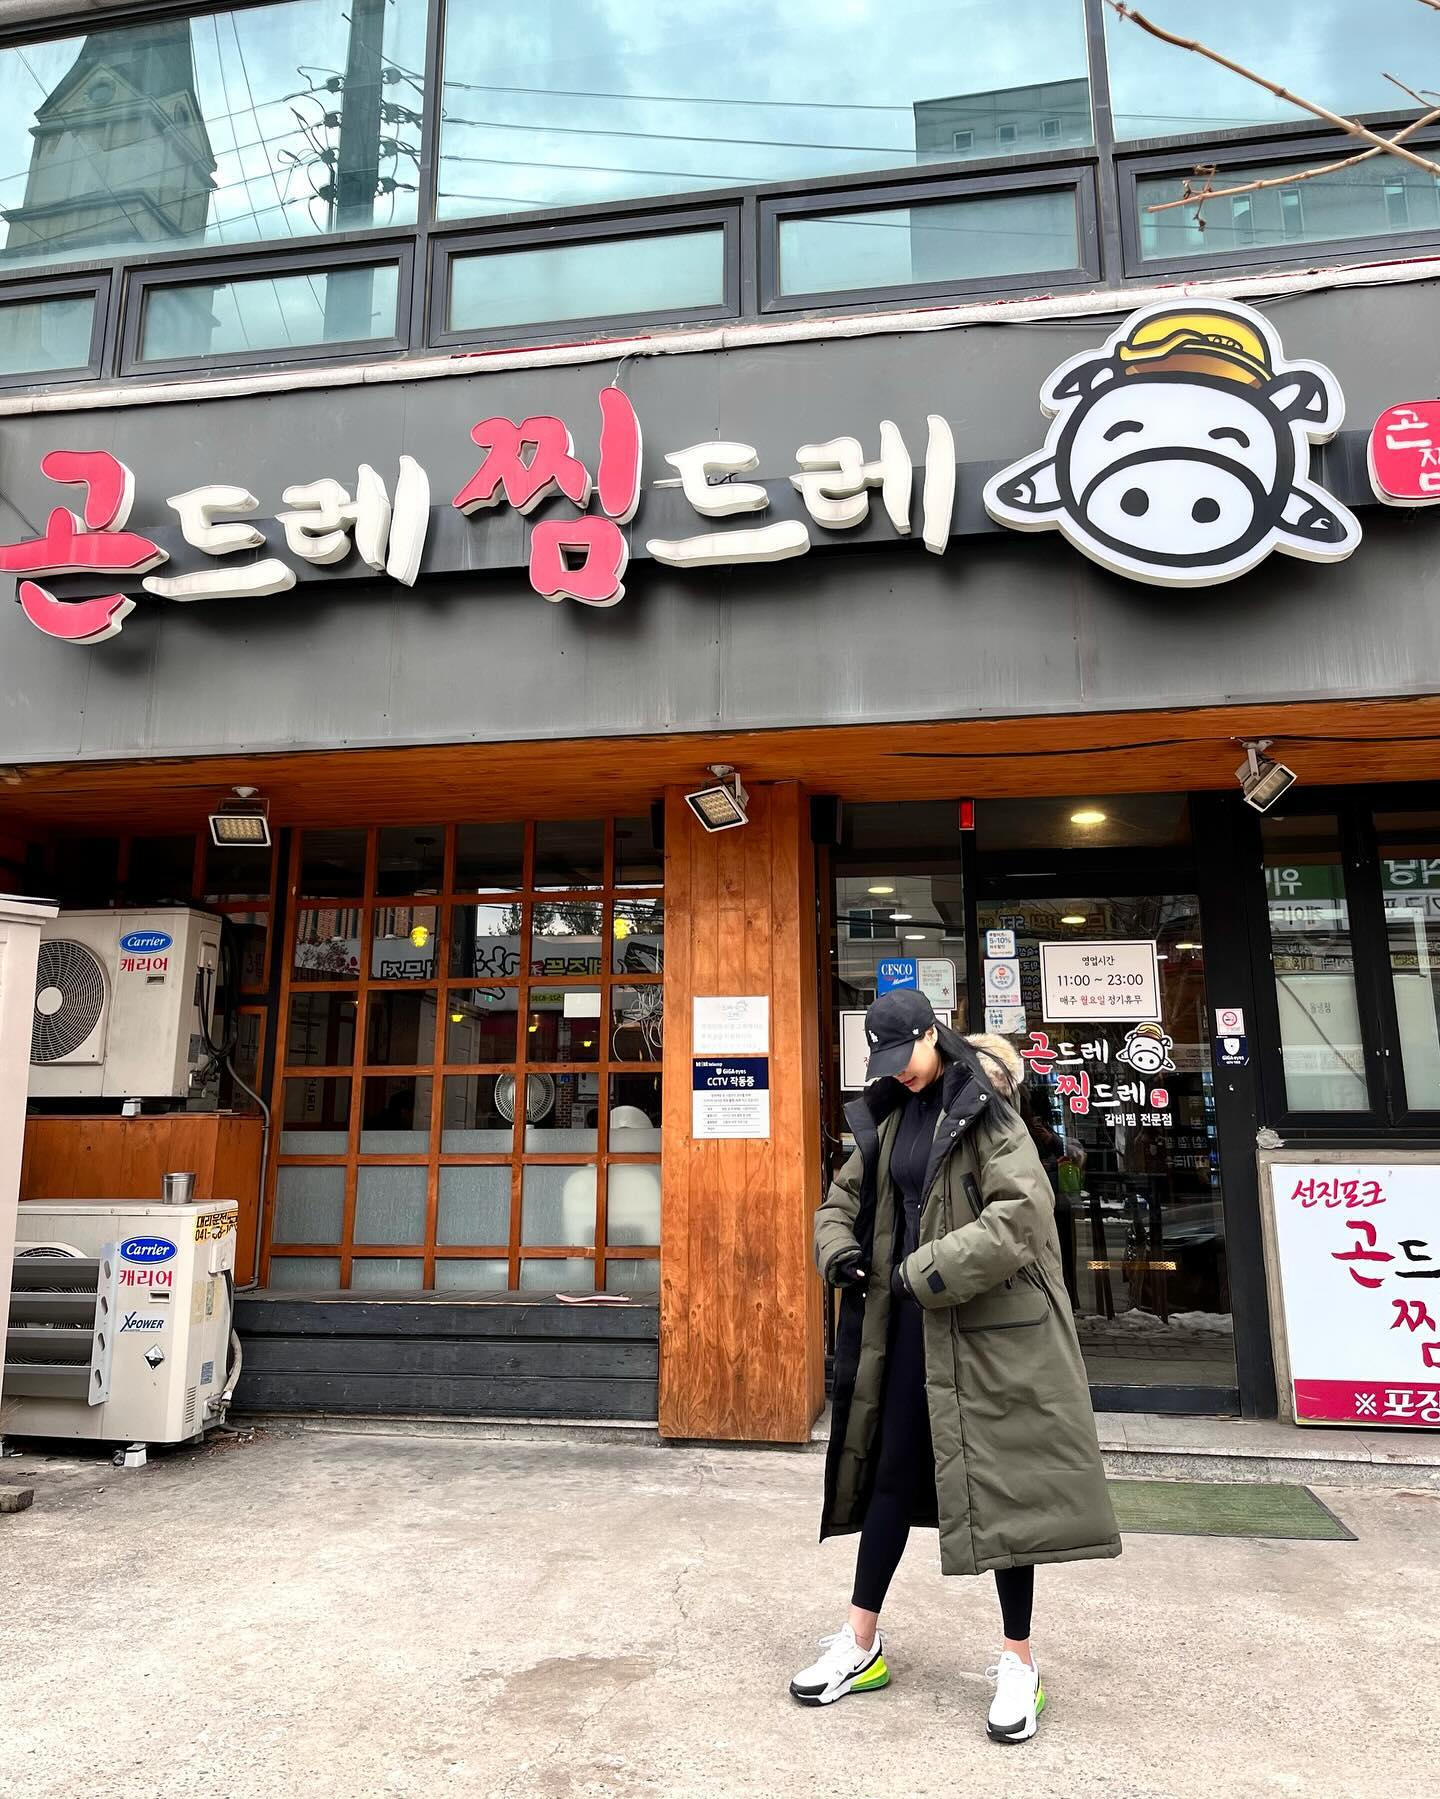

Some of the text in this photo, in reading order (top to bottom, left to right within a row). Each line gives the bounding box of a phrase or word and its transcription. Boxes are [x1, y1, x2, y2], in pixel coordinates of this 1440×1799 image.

[1386, 409, 1433, 450] 곤
[0, 387, 955, 644] 곤드레 찜드레
[127, 936, 166, 947] Carrier
[120, 957, 169, 972] 캐리어
[1082, 955, 1115, 966] 영업시간
[881, 963, 913, 976] CESCO
[1057, 975, 1091, 987] 11:00
[1107, 974, 1144, 986] 23:00
[1059, 994, 1142, 1006] 매주 월요일 정기휴무
[1020, 1031, 1109, 1075] 곤드레
[707, 1076, 755, 1088] CCTV 작동중
[1055, 1070, 1146, 1115] 찜드레
[1104, 1113, 1173, 1127] 갈비찜 전문점
[1291, 1178, 1387, 1209] 선진포크
[126, 1243, 170, 1256] Carrier
[118, 1269, 173, 1287] 캐리어
[120, 1311, 164, 1332] XPOWER
